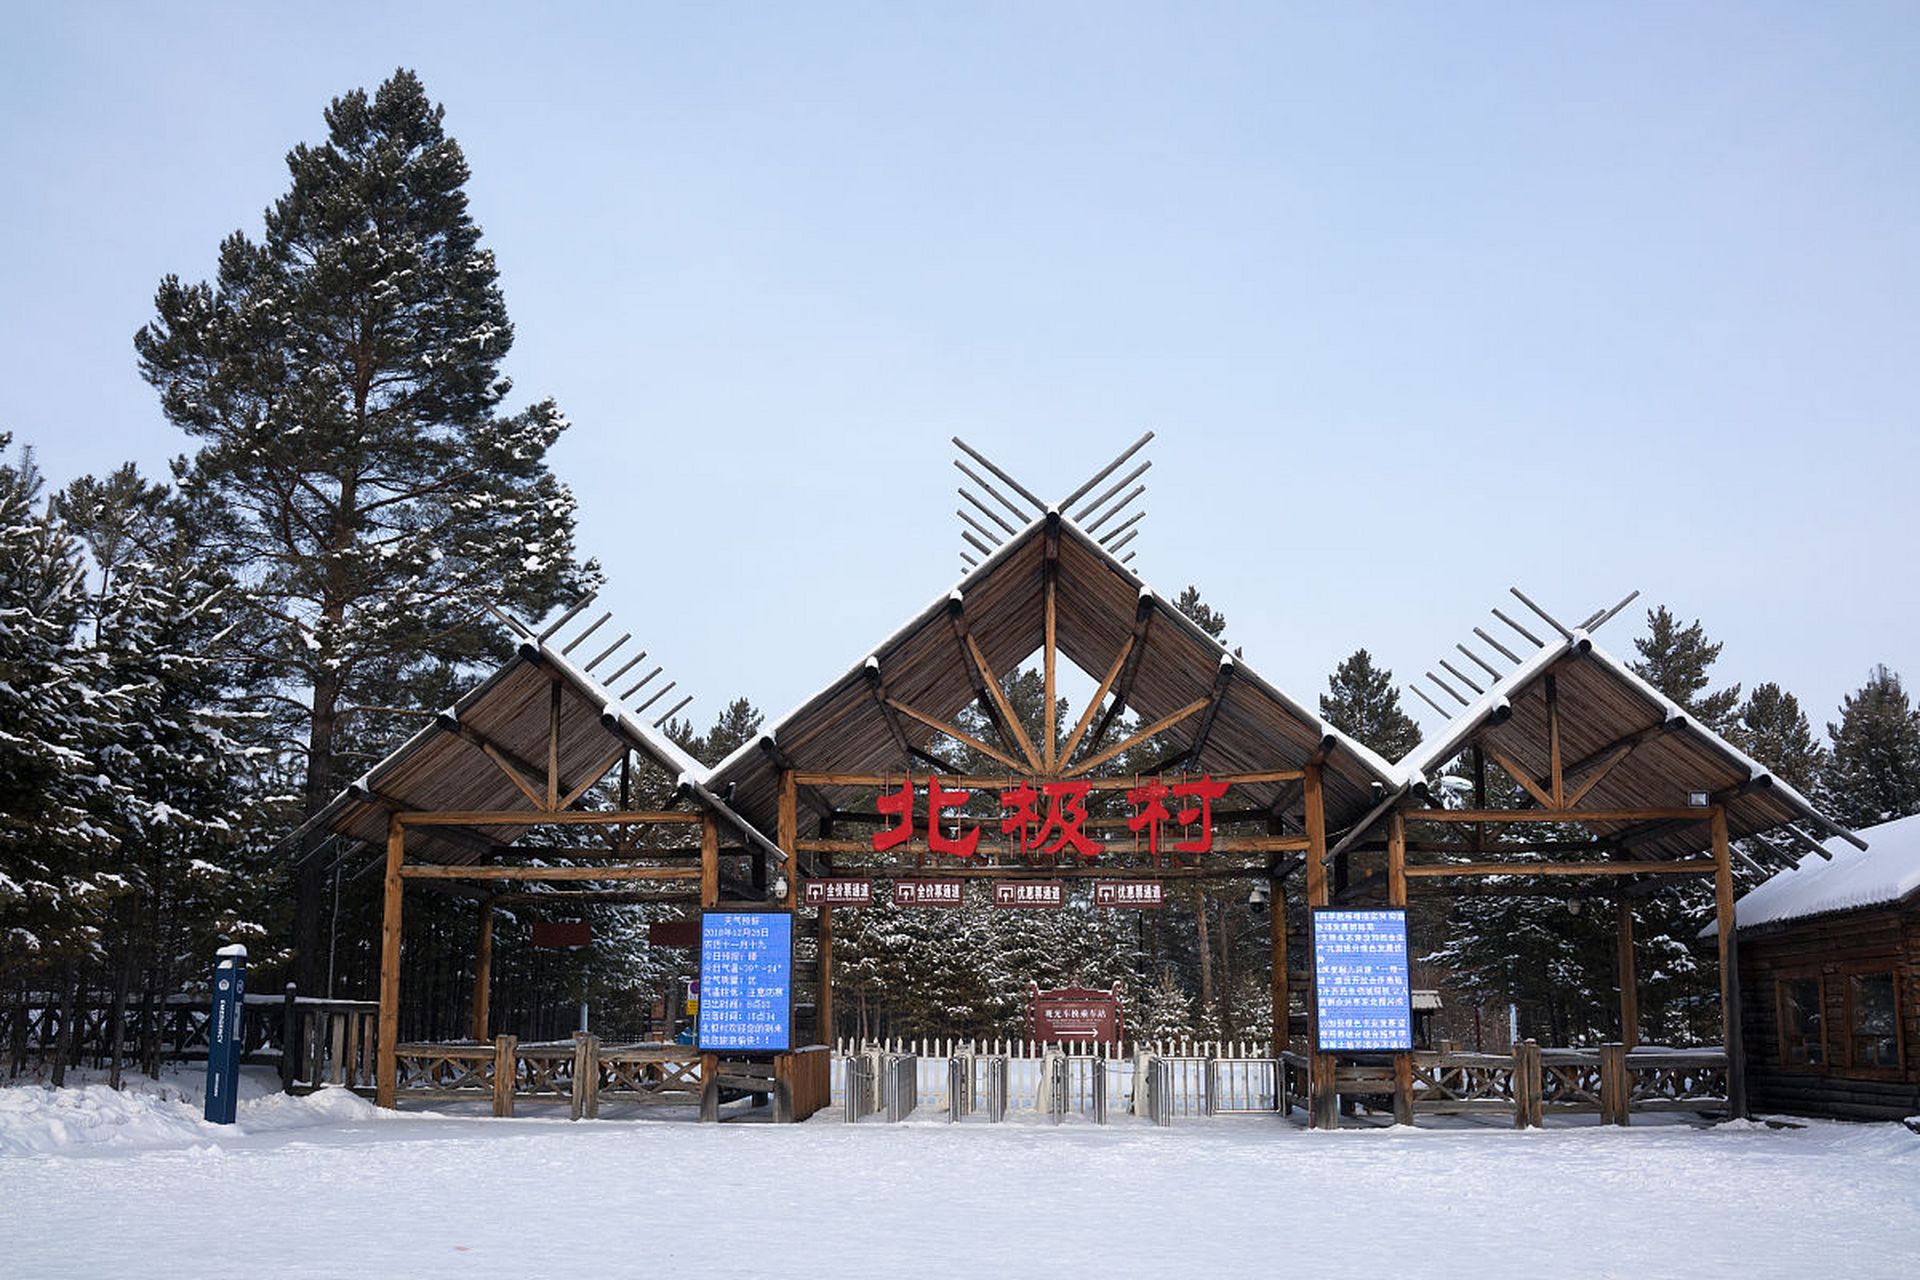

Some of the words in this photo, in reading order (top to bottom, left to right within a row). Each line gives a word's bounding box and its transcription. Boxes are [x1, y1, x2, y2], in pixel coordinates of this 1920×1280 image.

[872, 773, 1232, 857] 北极村
[827, 883, 869, 897] 全价票通道
[917, 884, 960, 898] 全价票通道
[1017, 886, 1060, 900] 优惠票通道
[1118, 885, 1162, 899] 优惠票通道
[724, 916, 760, 926] 天气预报
[217, 999, 226, 1043] EMERGENCY
